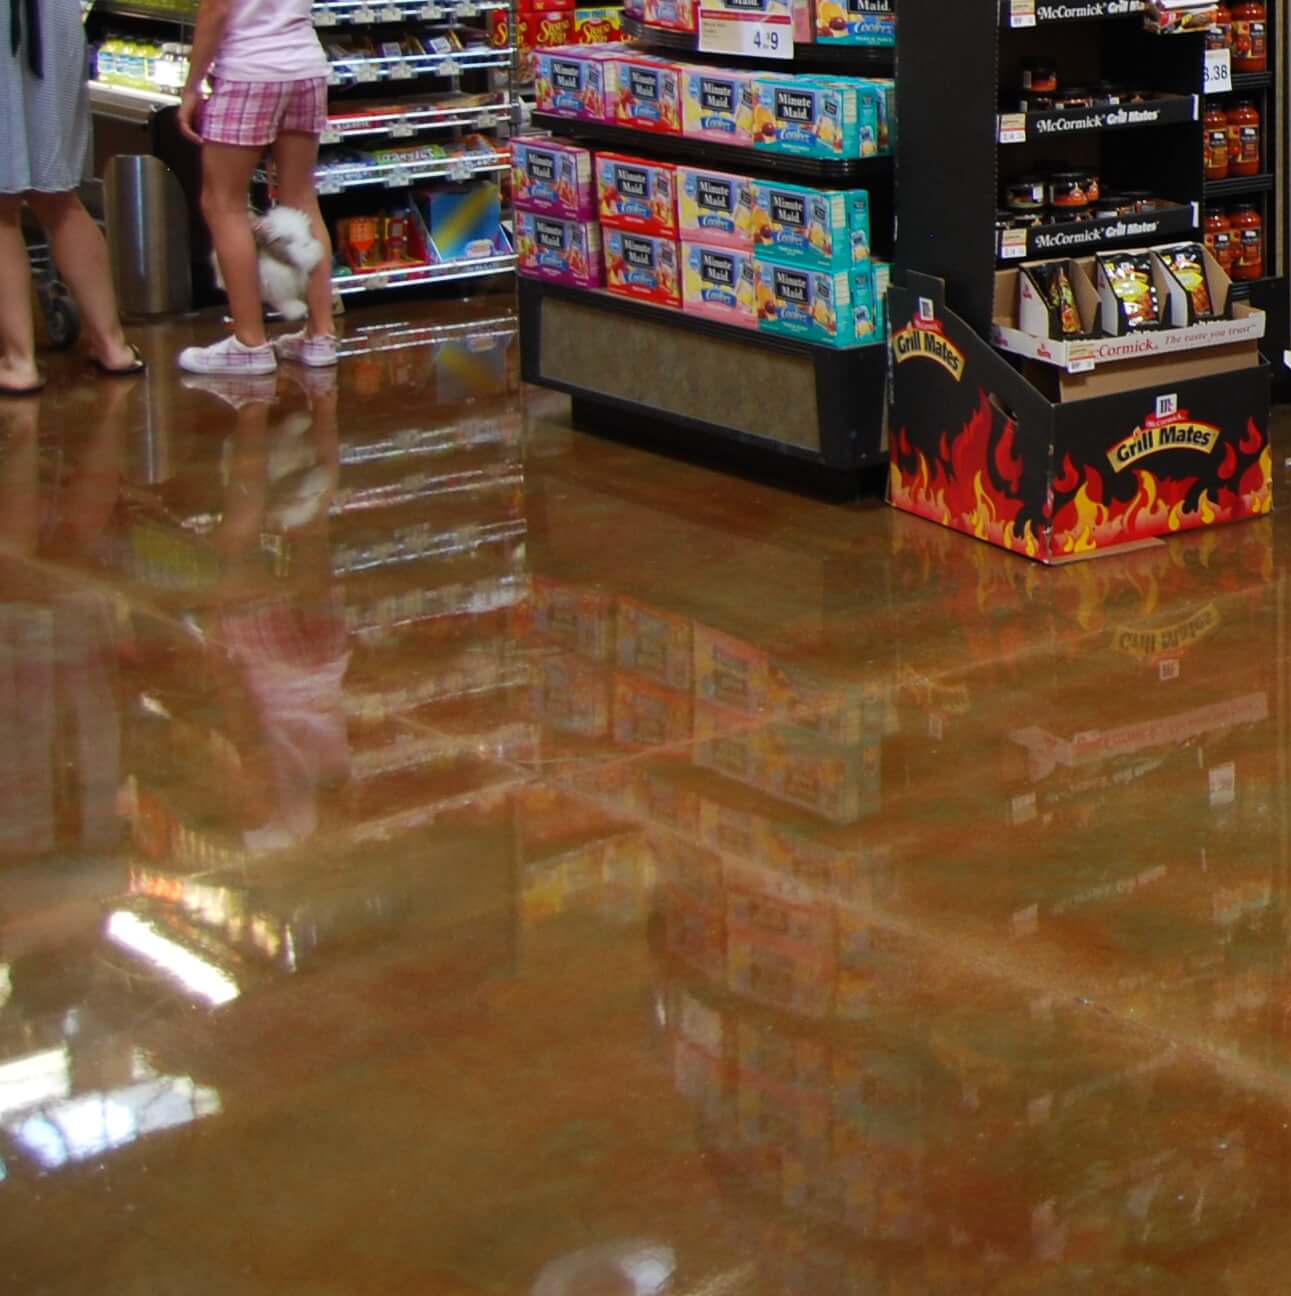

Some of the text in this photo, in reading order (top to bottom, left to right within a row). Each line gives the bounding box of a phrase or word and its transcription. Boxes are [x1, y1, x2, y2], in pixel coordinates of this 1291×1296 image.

[1037, 0, 1128, 20] McCormick Grill
[779, 93, 812, 108] Minute
[1037, 108, 1159, 134] McCormick Grill Mates
[1035, 221, 1157, 249] McCormick Grill Mates
[897, 330, 960, 372] Grill Mates
[1165, 332, 1181, 346] The
[1116, 425, 1211, 462] Grill Mates
